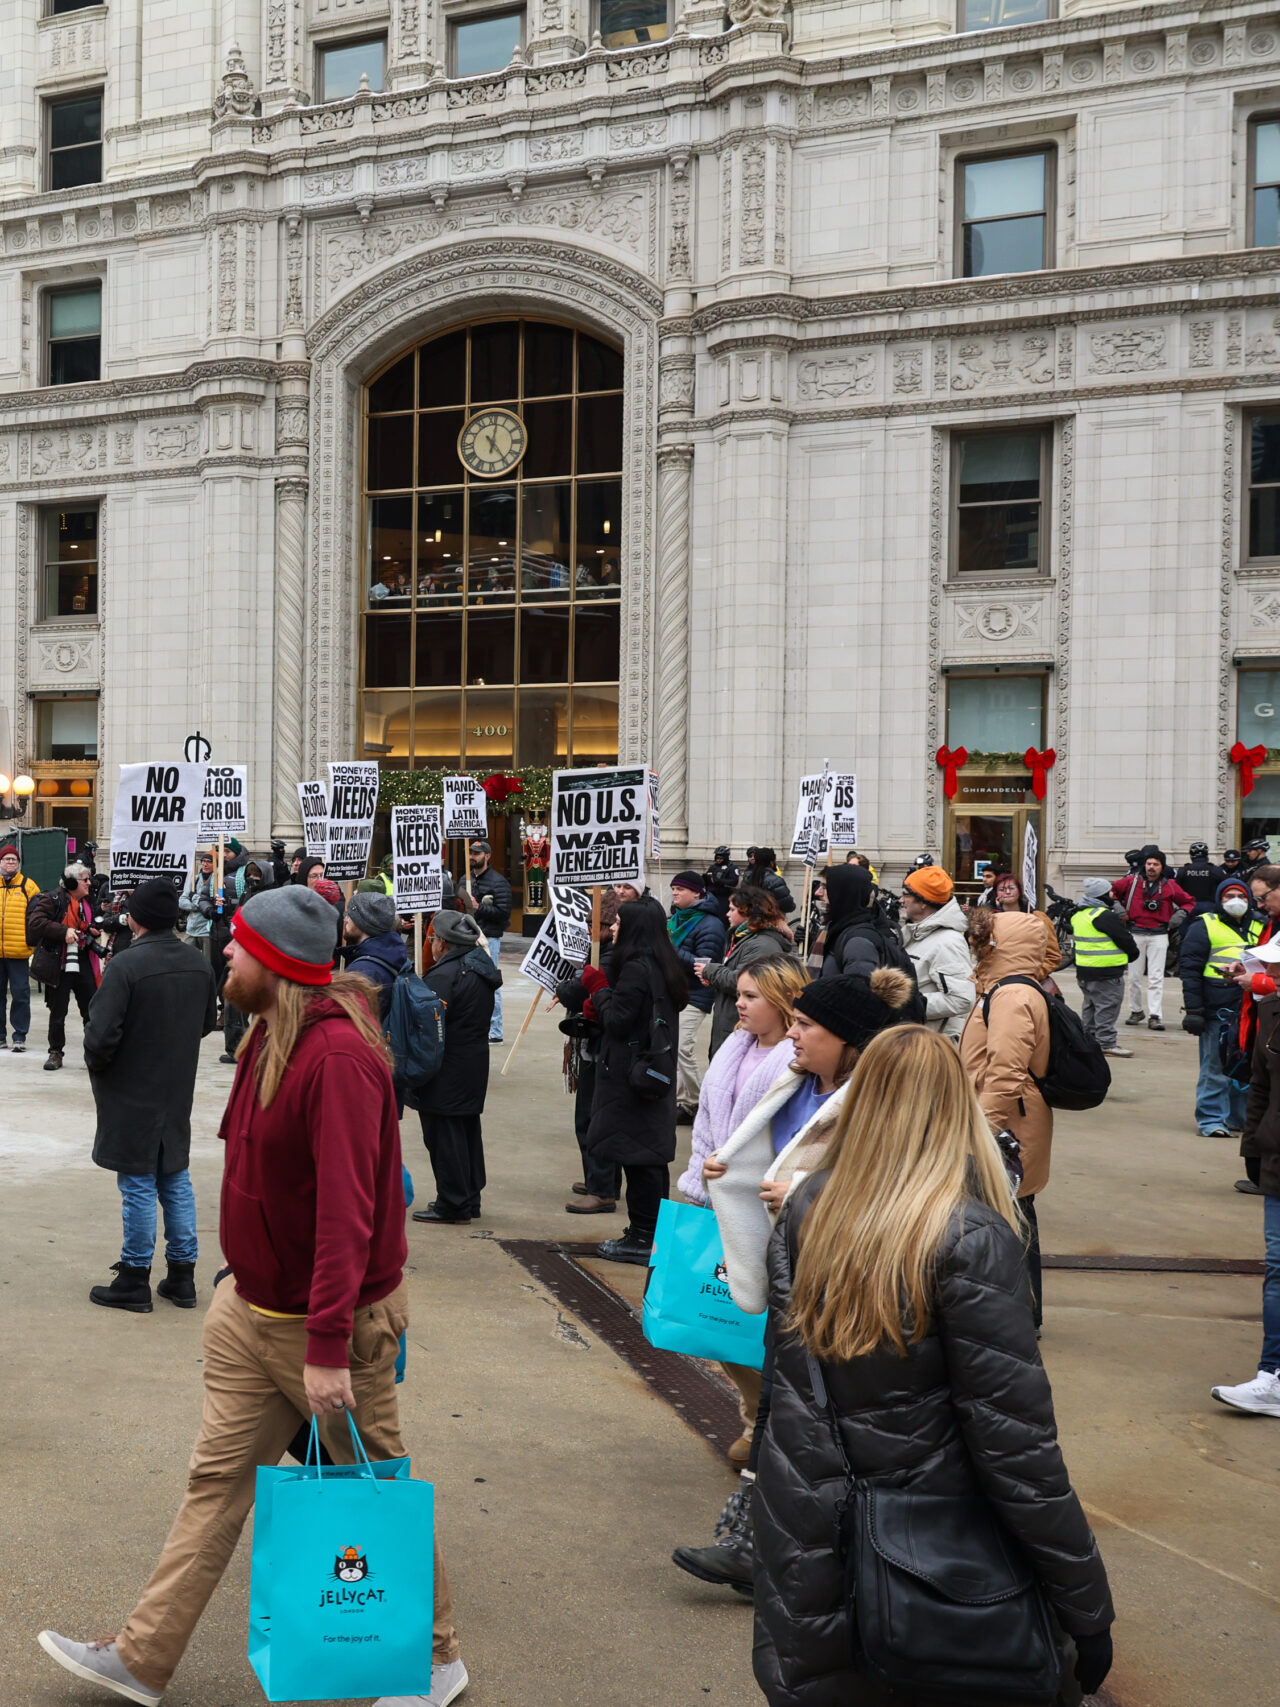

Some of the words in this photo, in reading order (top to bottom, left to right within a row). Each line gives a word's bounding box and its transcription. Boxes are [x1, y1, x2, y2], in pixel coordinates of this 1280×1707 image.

[472, 725, 507, 736] 400
[207, 767, 234, 777] NO
[332, 766, 362, 774] MONEY
[364, 767, 377, 775] FOR
[145, 766, 180, 793] NO
[333, 775, 377, 786] PEOPLE'S
[446, 780, 483, 793] HANDS
[304, 783, 320, 795] NO
[302, 795, 327, 817] BLOOD
[331, 786, 376, 819] NEEDS
[455, 793, 475, 805] OFF
[131, 795, 186, 822] WAR
[201, 802, 222, 820] FOR
[225, 801, 245, 819] OIL
[395, 807, 424, 815] MONEY
[452, 809, 479, 820] LATIN
[557, 792, 591, 828] NO
[596, 788, 642, 824] U.S.
[396, 814, 438, 823] PEOPLE'S
[448, 819, 483, 828] AMERICA!
[306, 822, 319, 842] FOR
[329, 826, 344, 841] NOT
[344, 826, 358, 841] WAR
[359, 825, 371, 840] WITH
[397, 823, 439, 857] NEEDS
[556, 829, 640, 850] WAR
[140, 830, 166, 851] ON
[112, 852, 187, 869] VENEZUELA
[556, 846, 639, 873] VENEZUELA
[397, 862, 430, 876] NOT
[579, 873, 605, 881] SOCIALISM
[610, 871, 638, 879] LIBERATION
[397, 877, 412, 893] WAR
[414, 876, 441, 892] MACHINE
[553, 887, 590, 913] US
[559, 920, 568, 933] OF
[531, 940, 561, 975] FOR
[323, 1635, 337, 1643] For
[337, 1635, 350, 1643] the
[350, 1635, 363, 1644] joy
[364, 1634, 373, 1642] of
[373, 1634, 381, 1642] it.
